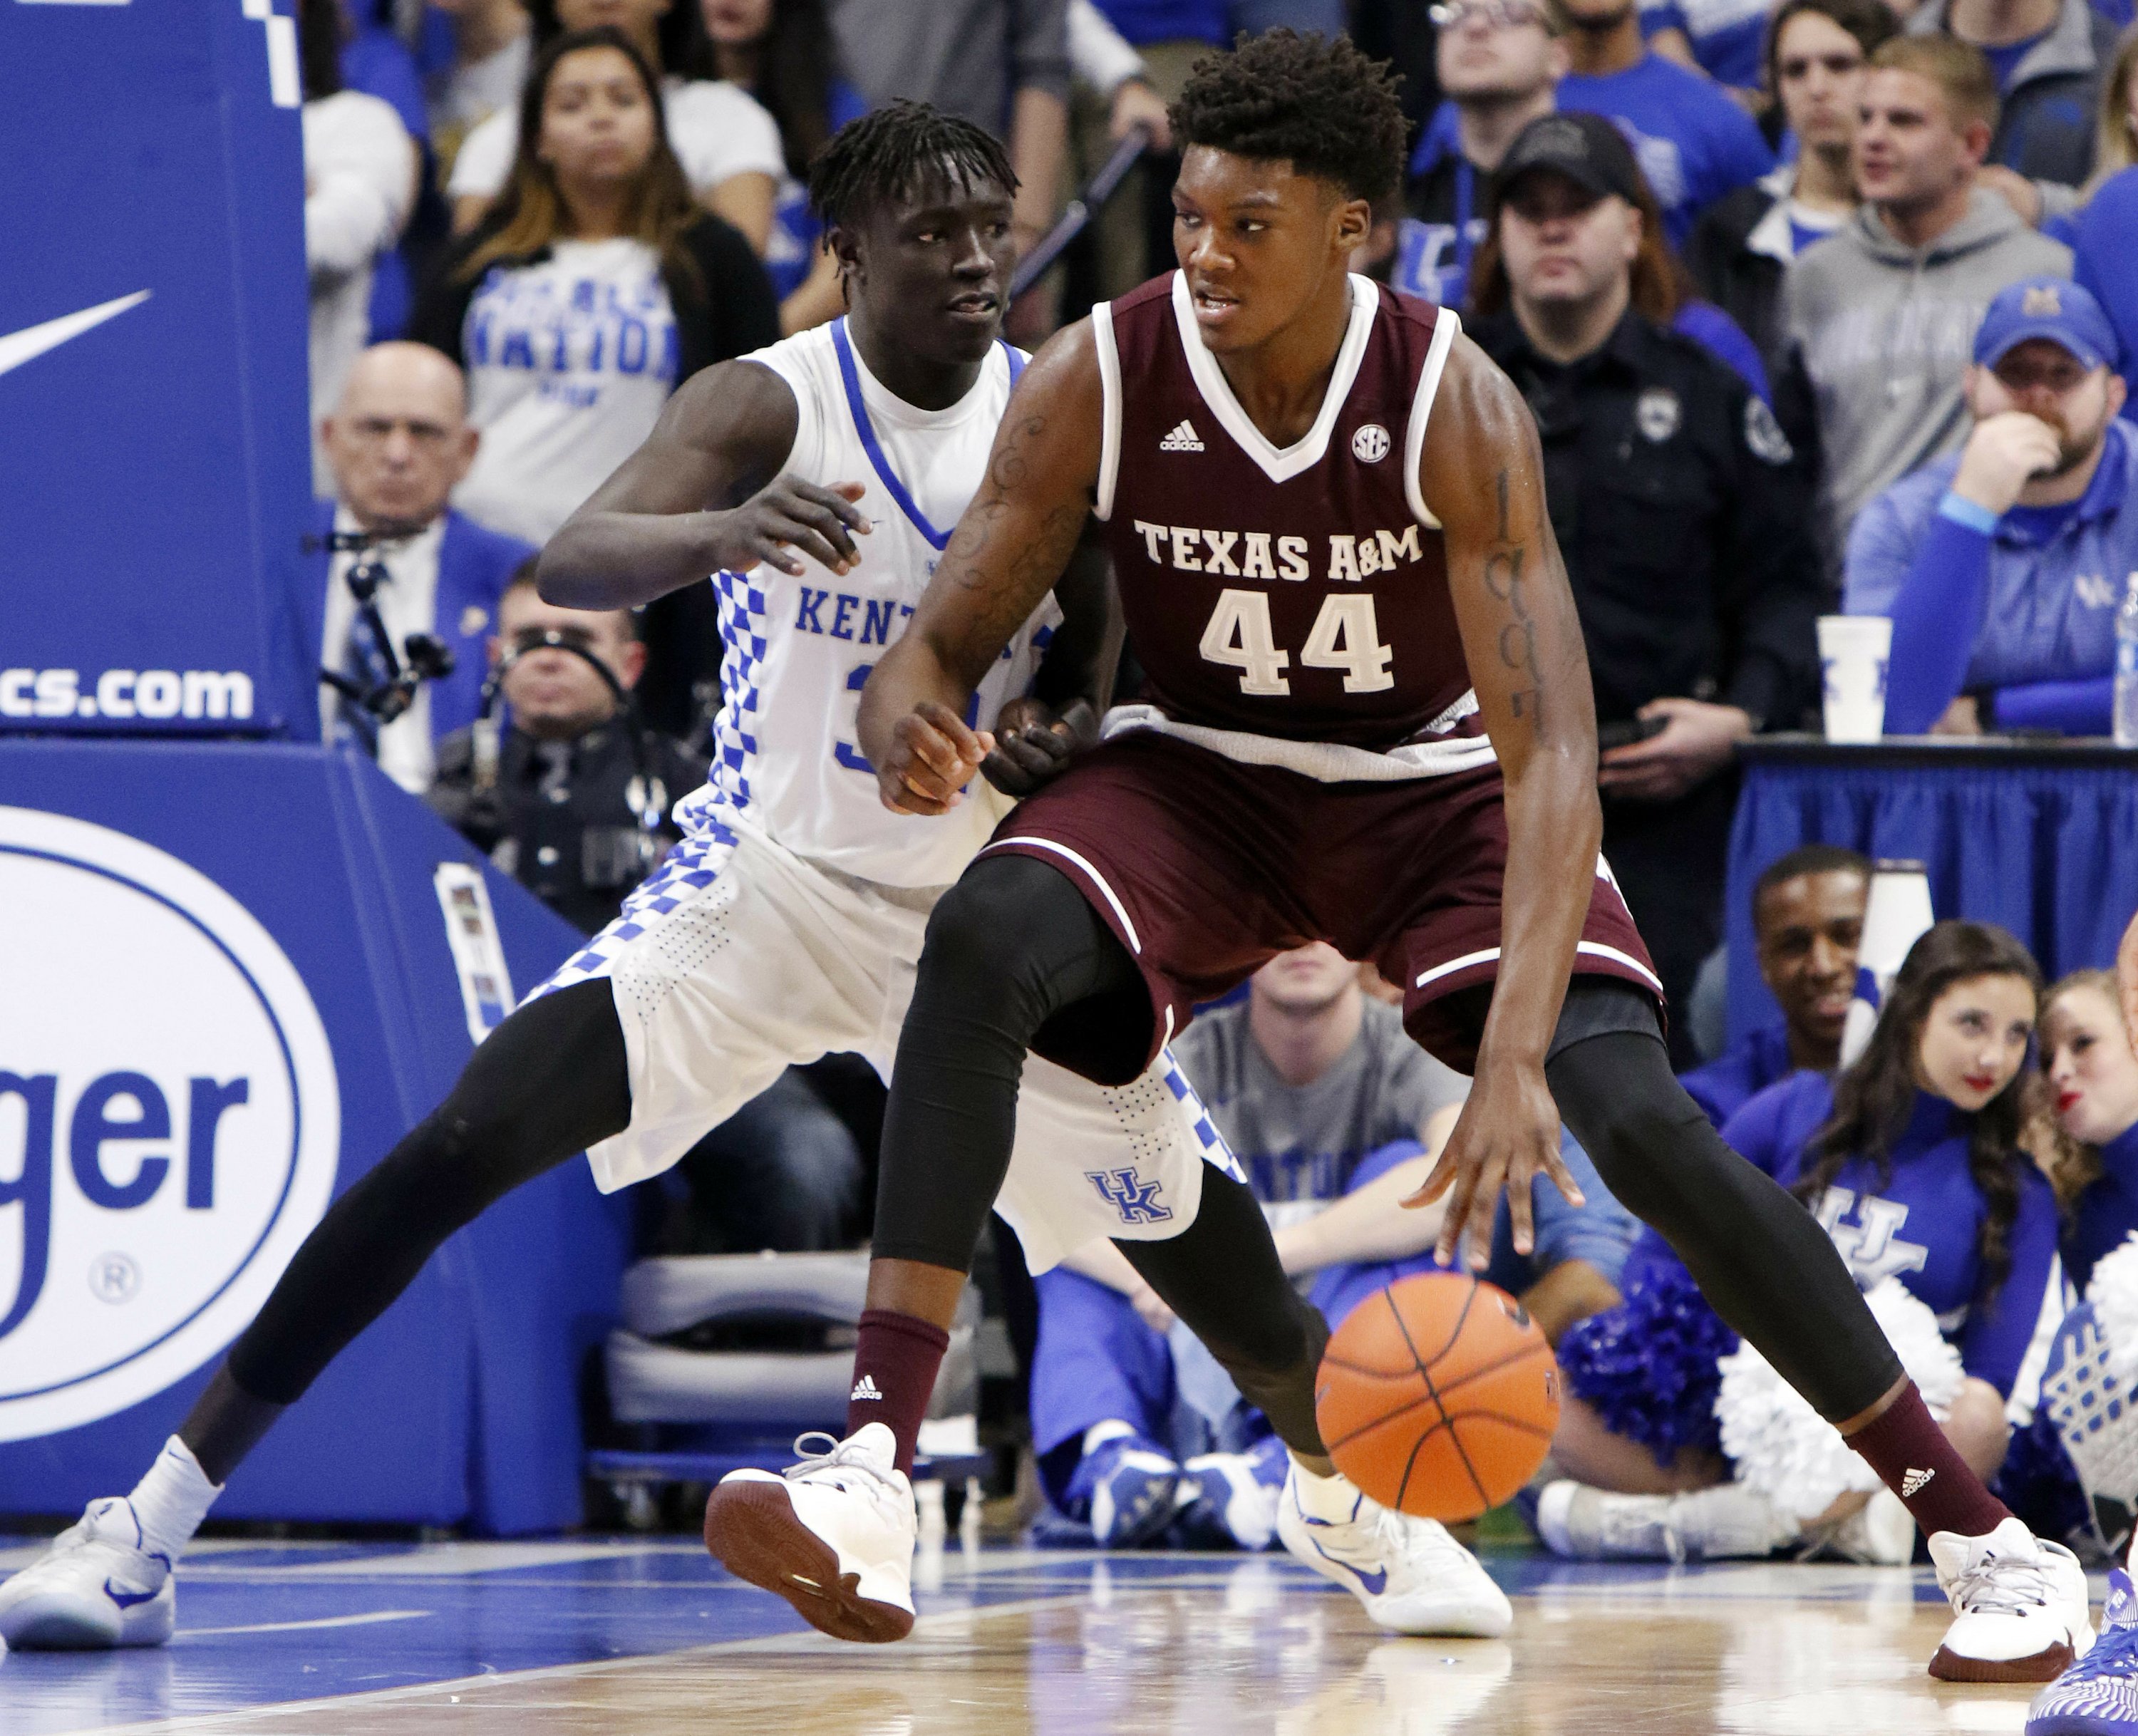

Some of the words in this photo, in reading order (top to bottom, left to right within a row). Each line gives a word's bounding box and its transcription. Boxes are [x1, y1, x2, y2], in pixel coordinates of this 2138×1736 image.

[1160, 440, 1205, 452] adidas
[1355, 426, 1388, 461] SEC
[1133, 519, 1310, 582] TEXAS
[1327, 524, 1423, 582] A&M
[795, 587, 916, 645] KEN
[1199, 588, 1395, 696] 44
[0, 668, 253, 719] cs.com
[1084, 1167, 1173, 1224] UK
[851, 1390, 883, 1401] adidas
[1902, 1468, 1936, 1497] adidas
